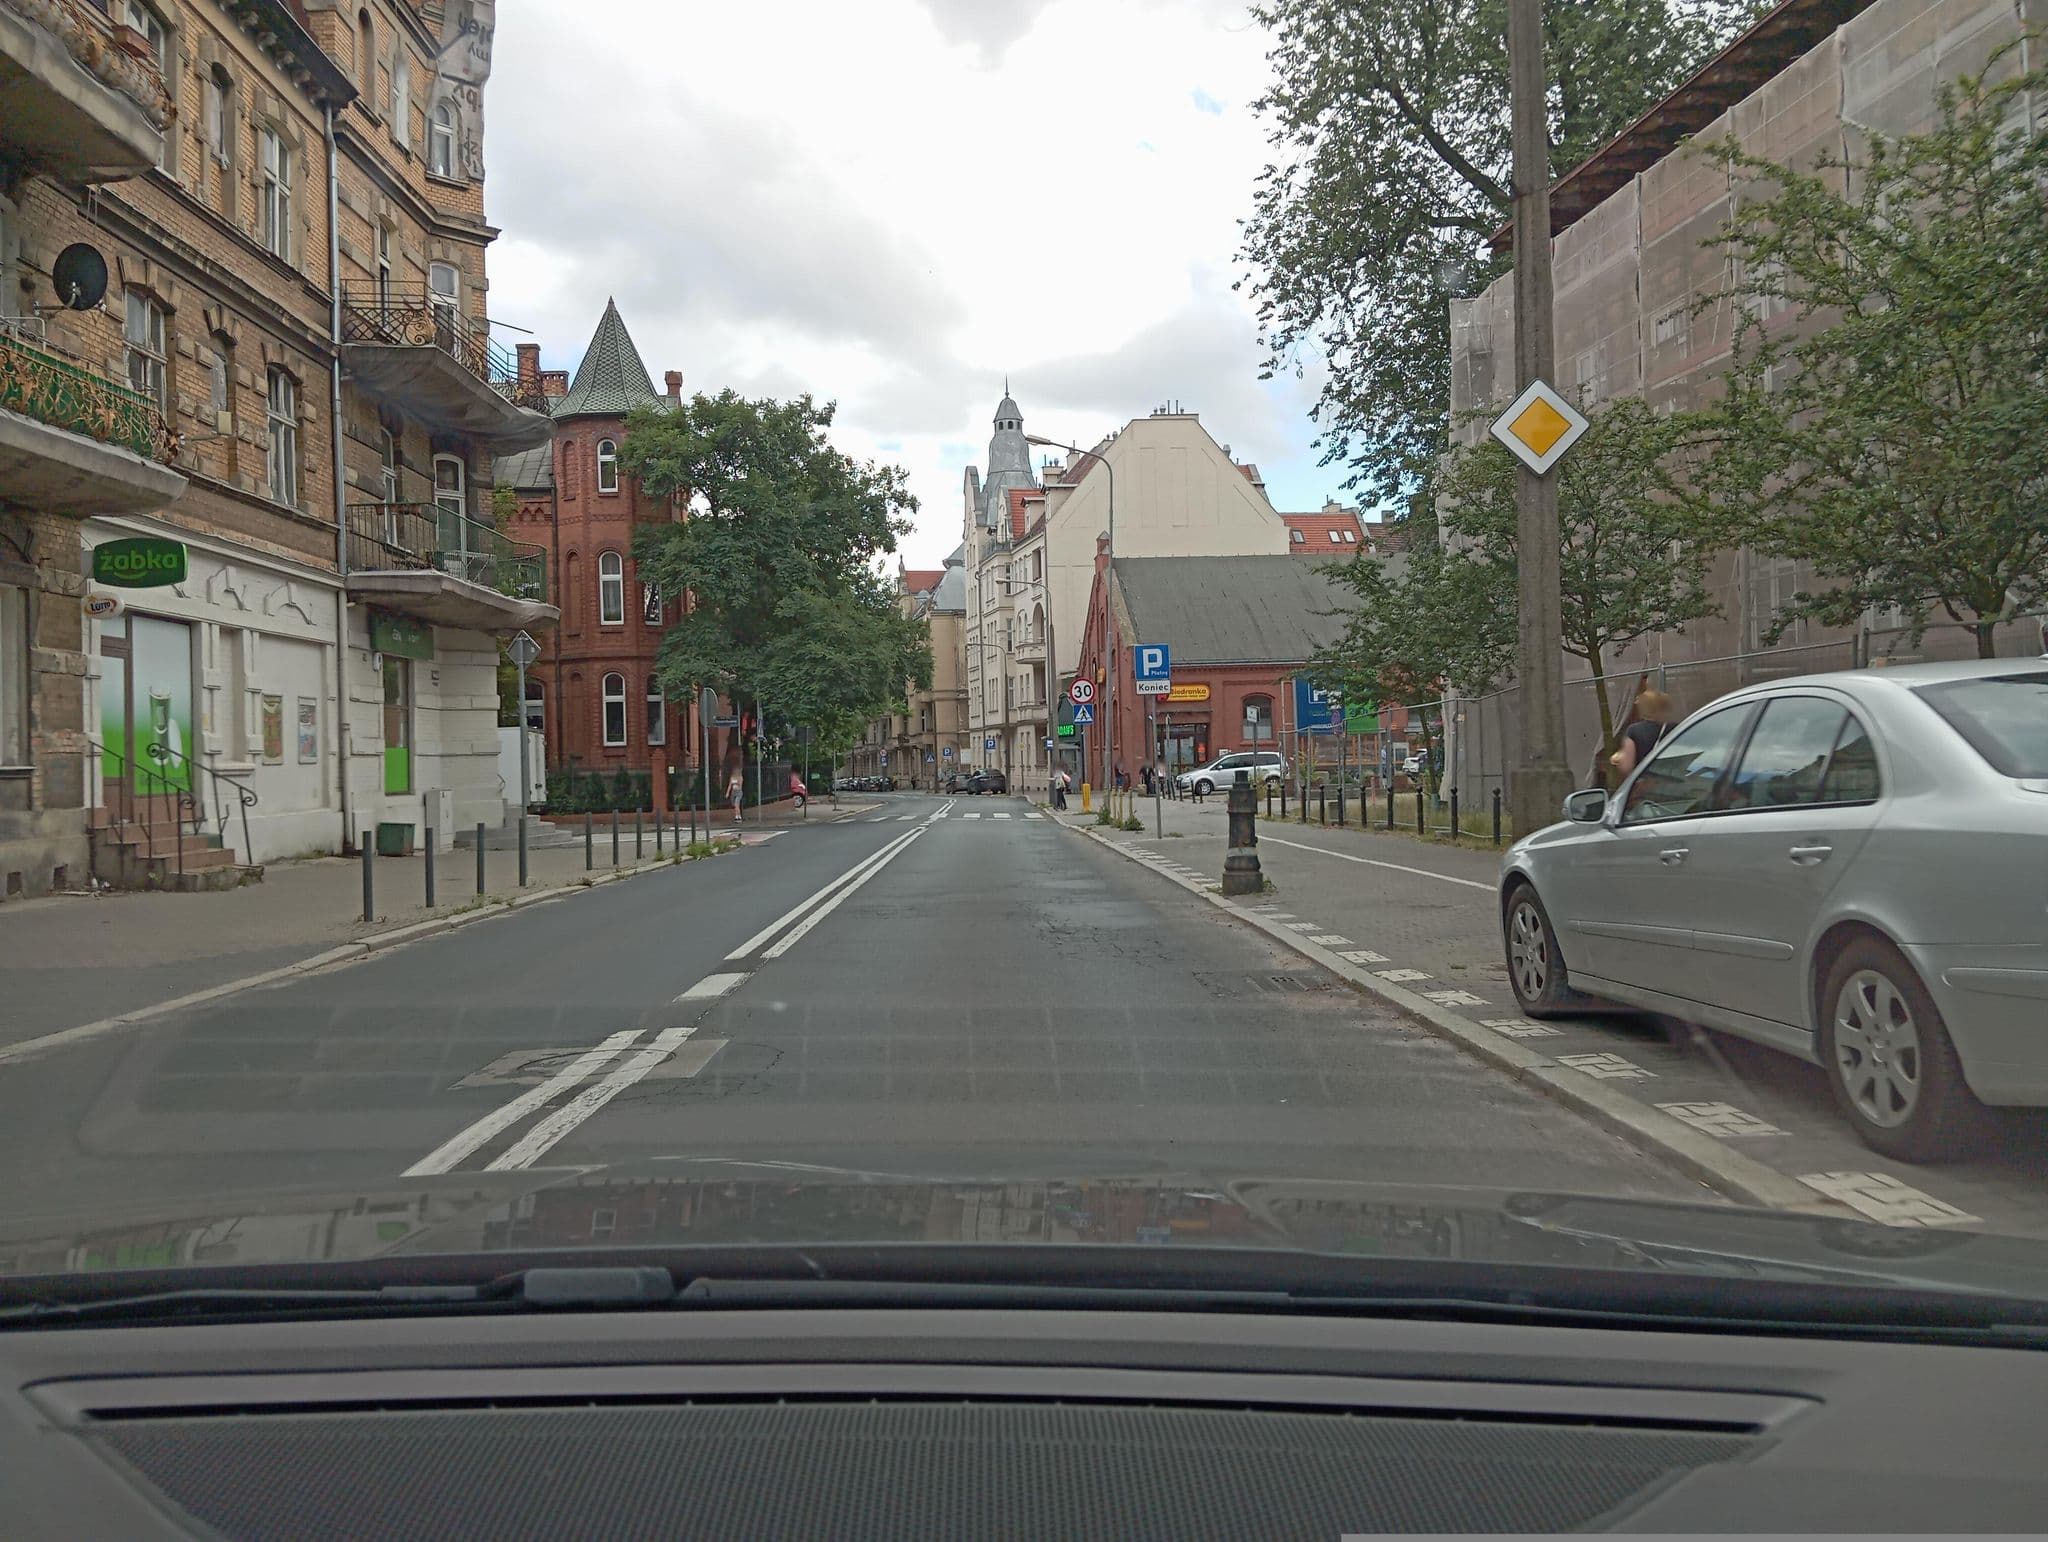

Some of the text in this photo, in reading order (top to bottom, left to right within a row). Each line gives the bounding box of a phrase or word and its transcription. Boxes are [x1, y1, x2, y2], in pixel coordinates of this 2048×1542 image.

[100, 549, 178, 571] żabka
[1143, 648, 1163, 676] P
[1074, 685, 1092, 698] 30
[1138, 683, 1169, 692] Koniec
